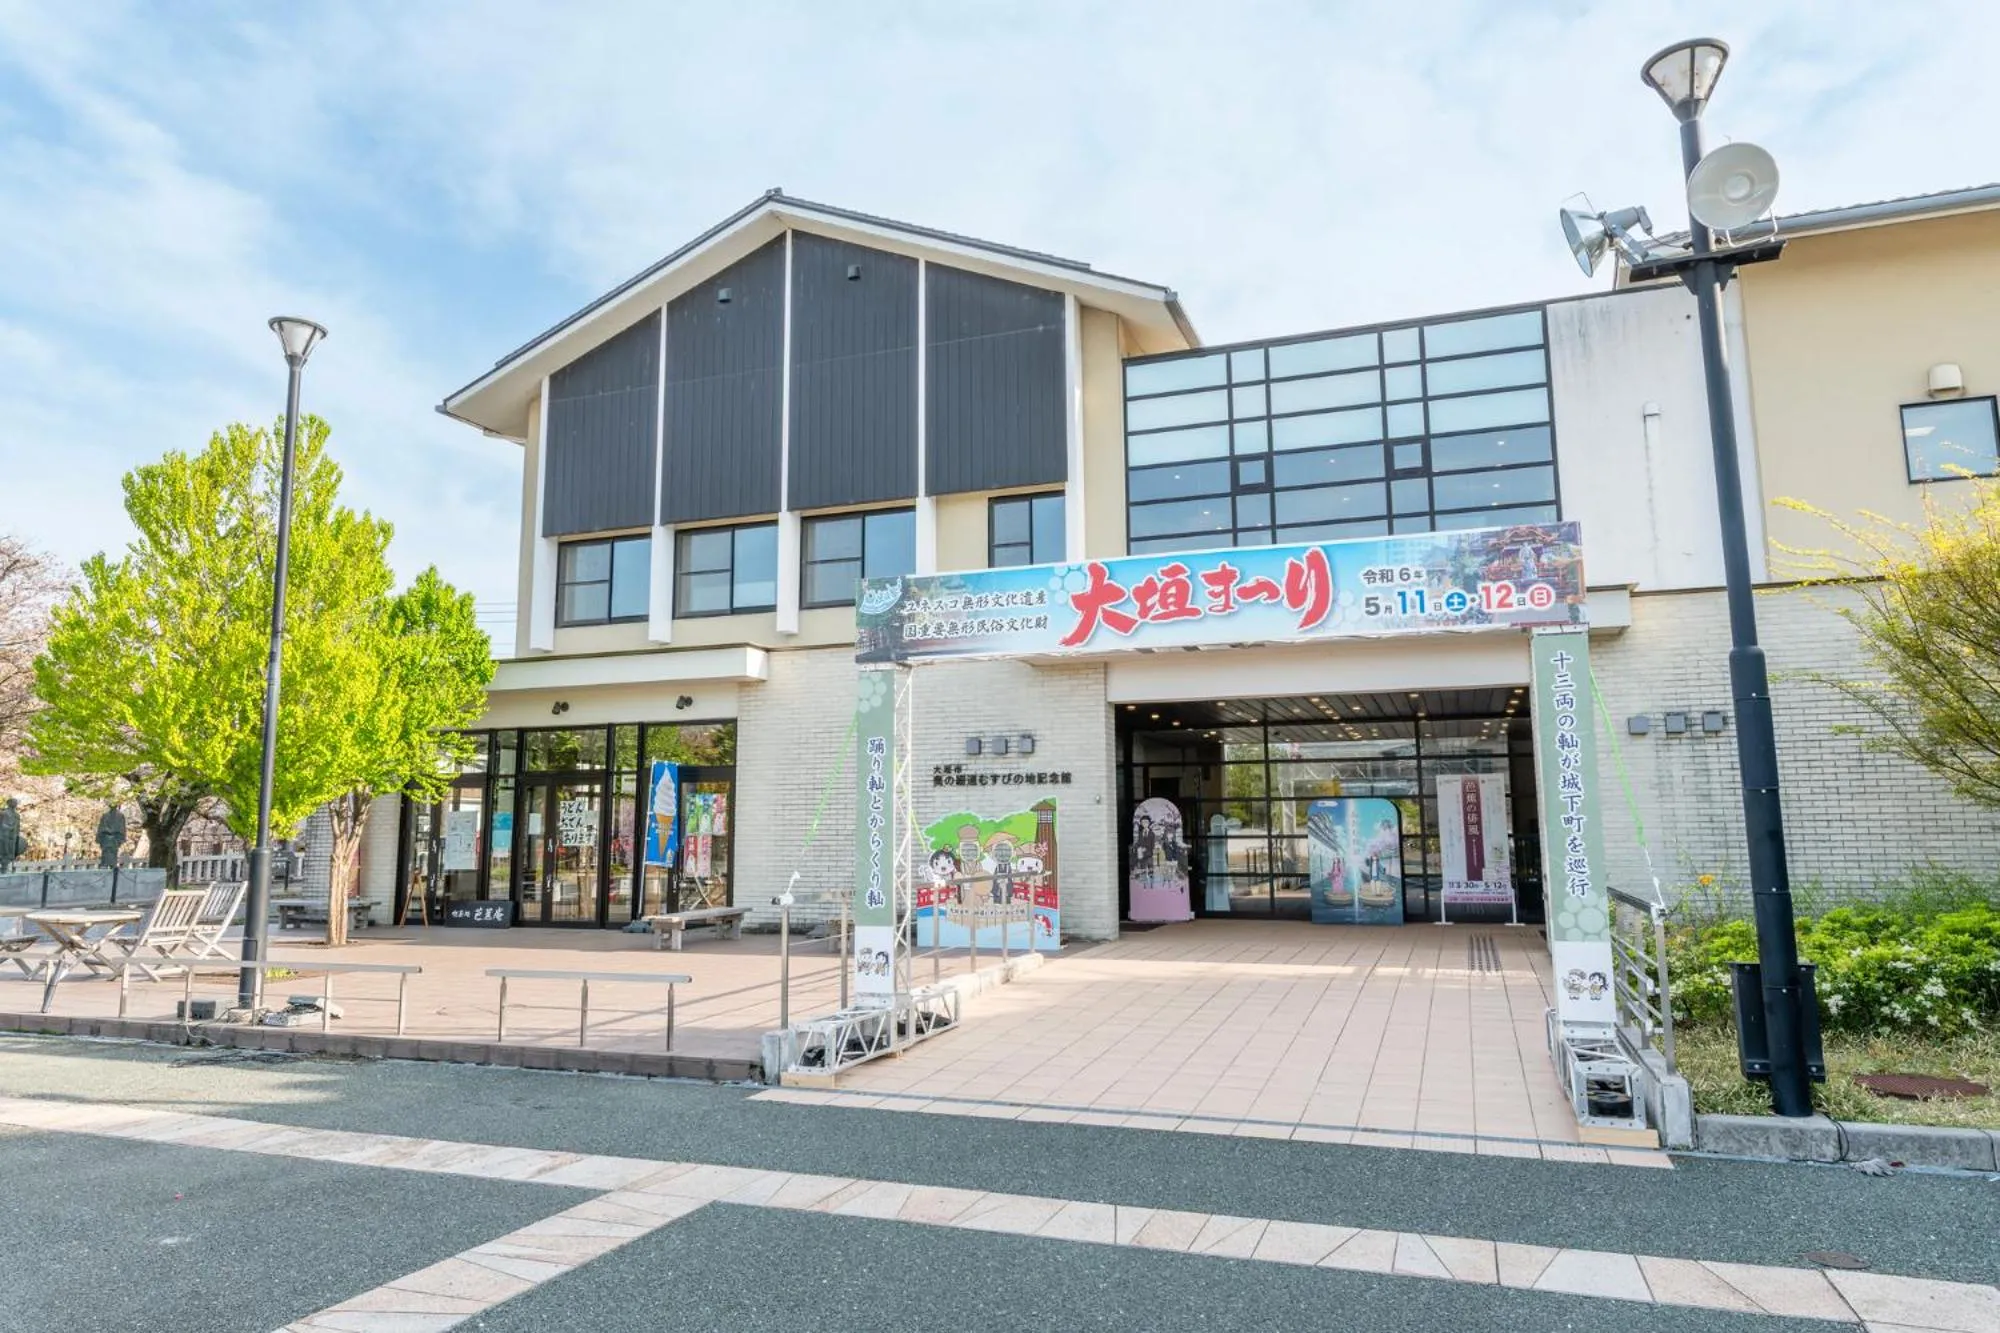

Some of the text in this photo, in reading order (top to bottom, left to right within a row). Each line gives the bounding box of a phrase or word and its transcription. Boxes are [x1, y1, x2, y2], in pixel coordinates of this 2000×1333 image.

[1362, 567, 1424, 584] 令和6年
[905, 589, 1048, 613] ユネスコ無形文化遺産
[1058, 549, 1332, 647] 大垣まつり
